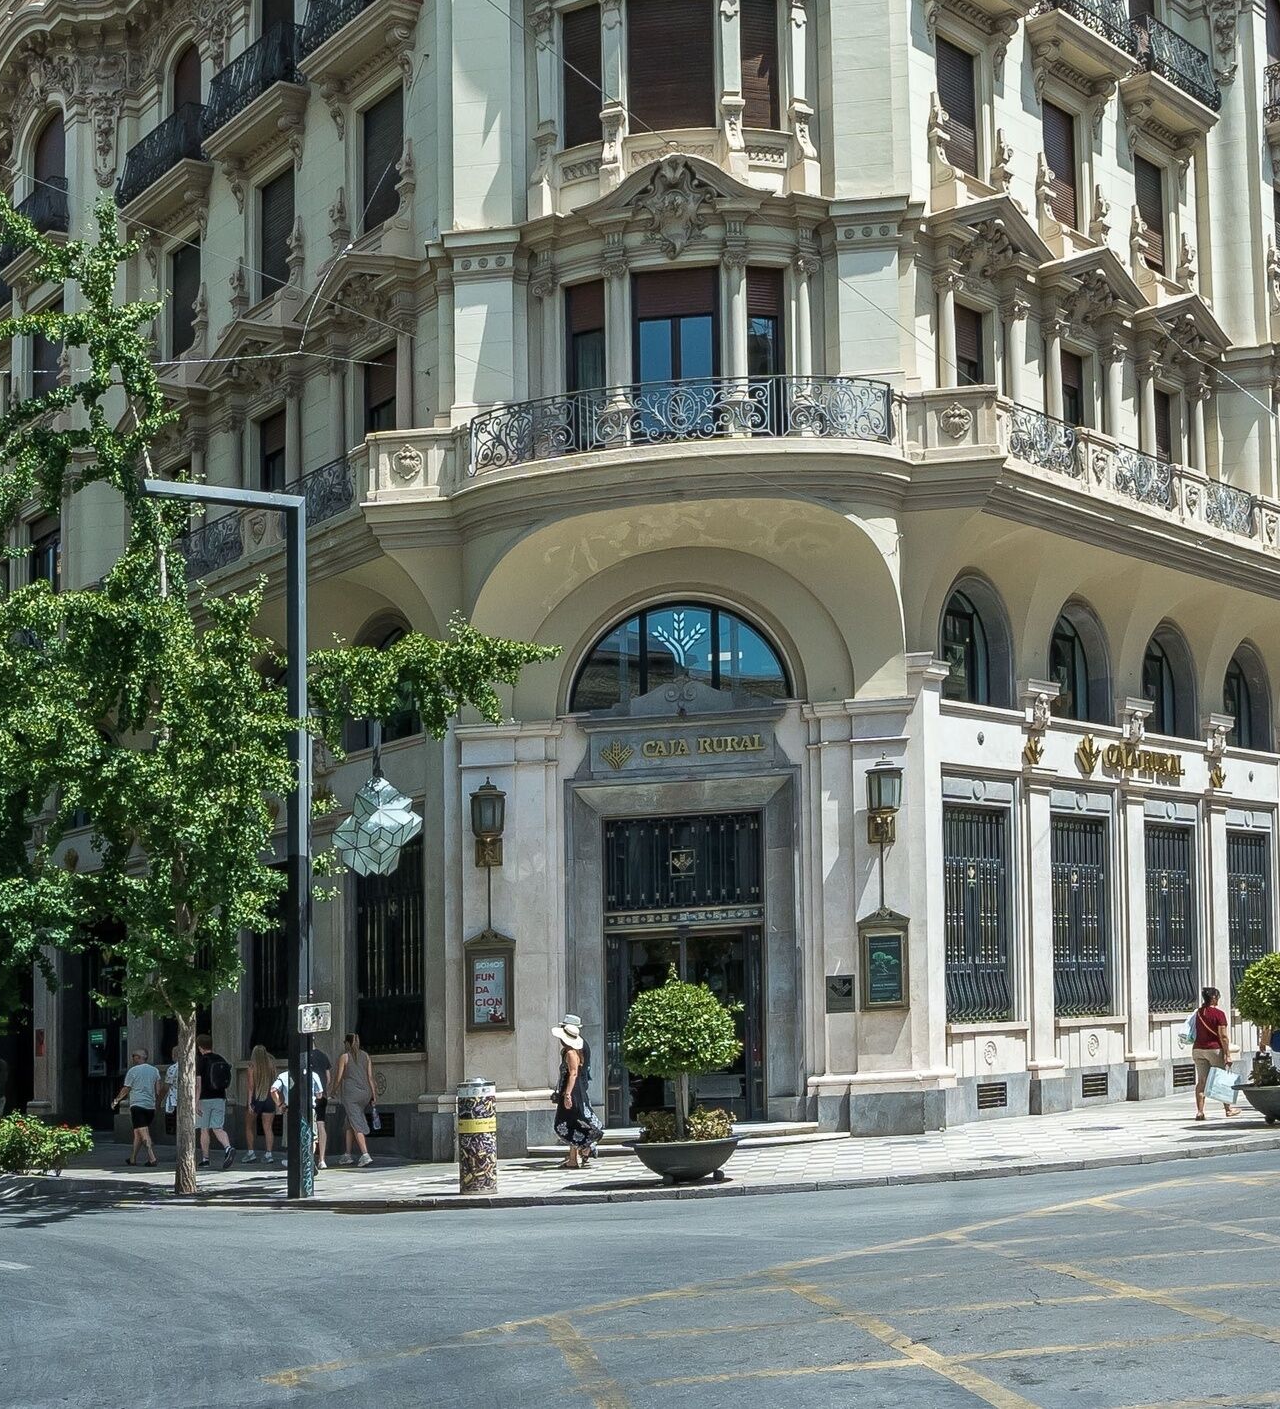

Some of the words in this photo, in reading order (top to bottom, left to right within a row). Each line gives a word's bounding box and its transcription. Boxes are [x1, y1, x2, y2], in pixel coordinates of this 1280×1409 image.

[642, 738, 690, 758] CAJA
[697, 734, 766, 755] RURAL
[475, 973, 495, 981] FUN
[475, 986, 489, 994] DA
